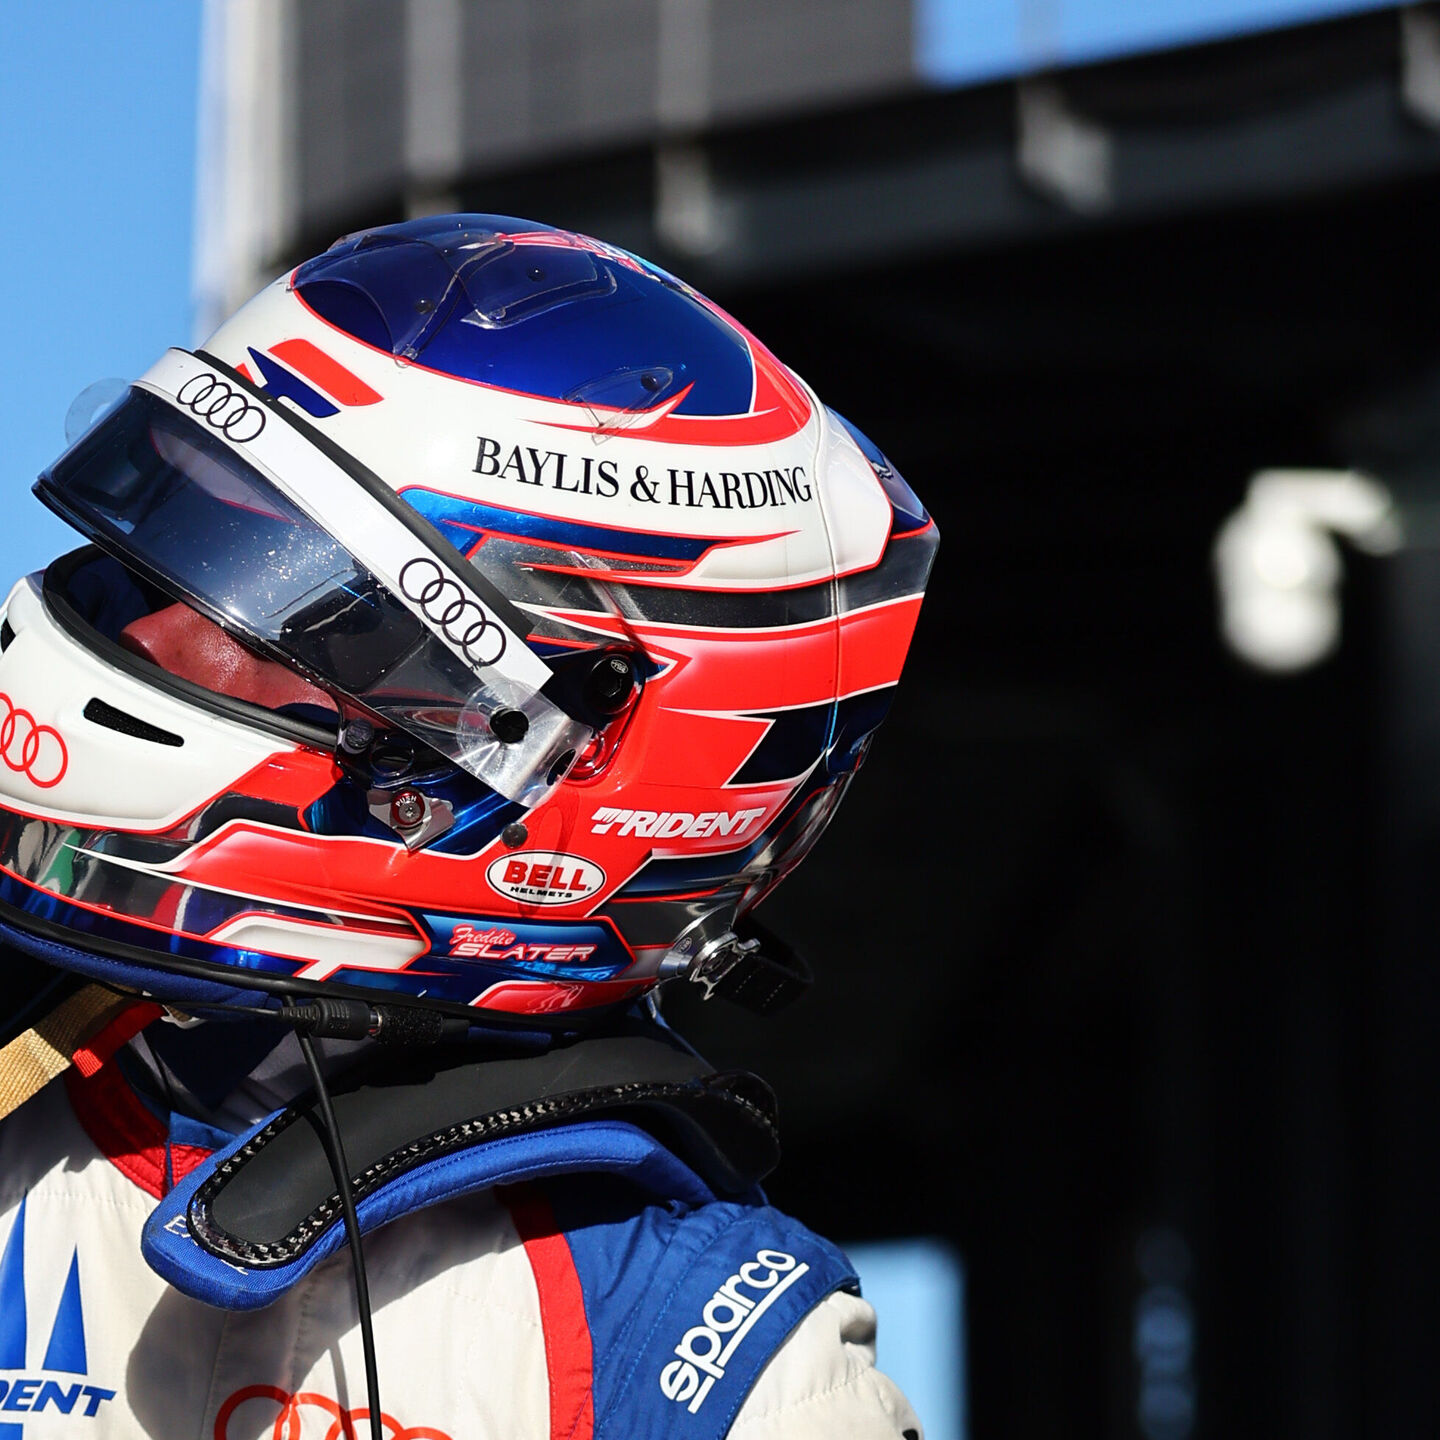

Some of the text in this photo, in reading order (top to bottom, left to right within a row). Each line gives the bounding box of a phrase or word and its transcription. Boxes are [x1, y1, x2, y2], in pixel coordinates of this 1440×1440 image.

[472, 436, 813, 510] BAYLIS & HARDING
[395, 795, 417, 807] PUSH
[590, 806, 767, 838] TRIDENT
[502, 860, 588, 891] BELL
[510, 886, 573, 898] HELMETS
[451, 925, 516, 946] Freddie
[452, 943, 596, 962] SLATER
[659, 1249, 798, 1404] sparco
